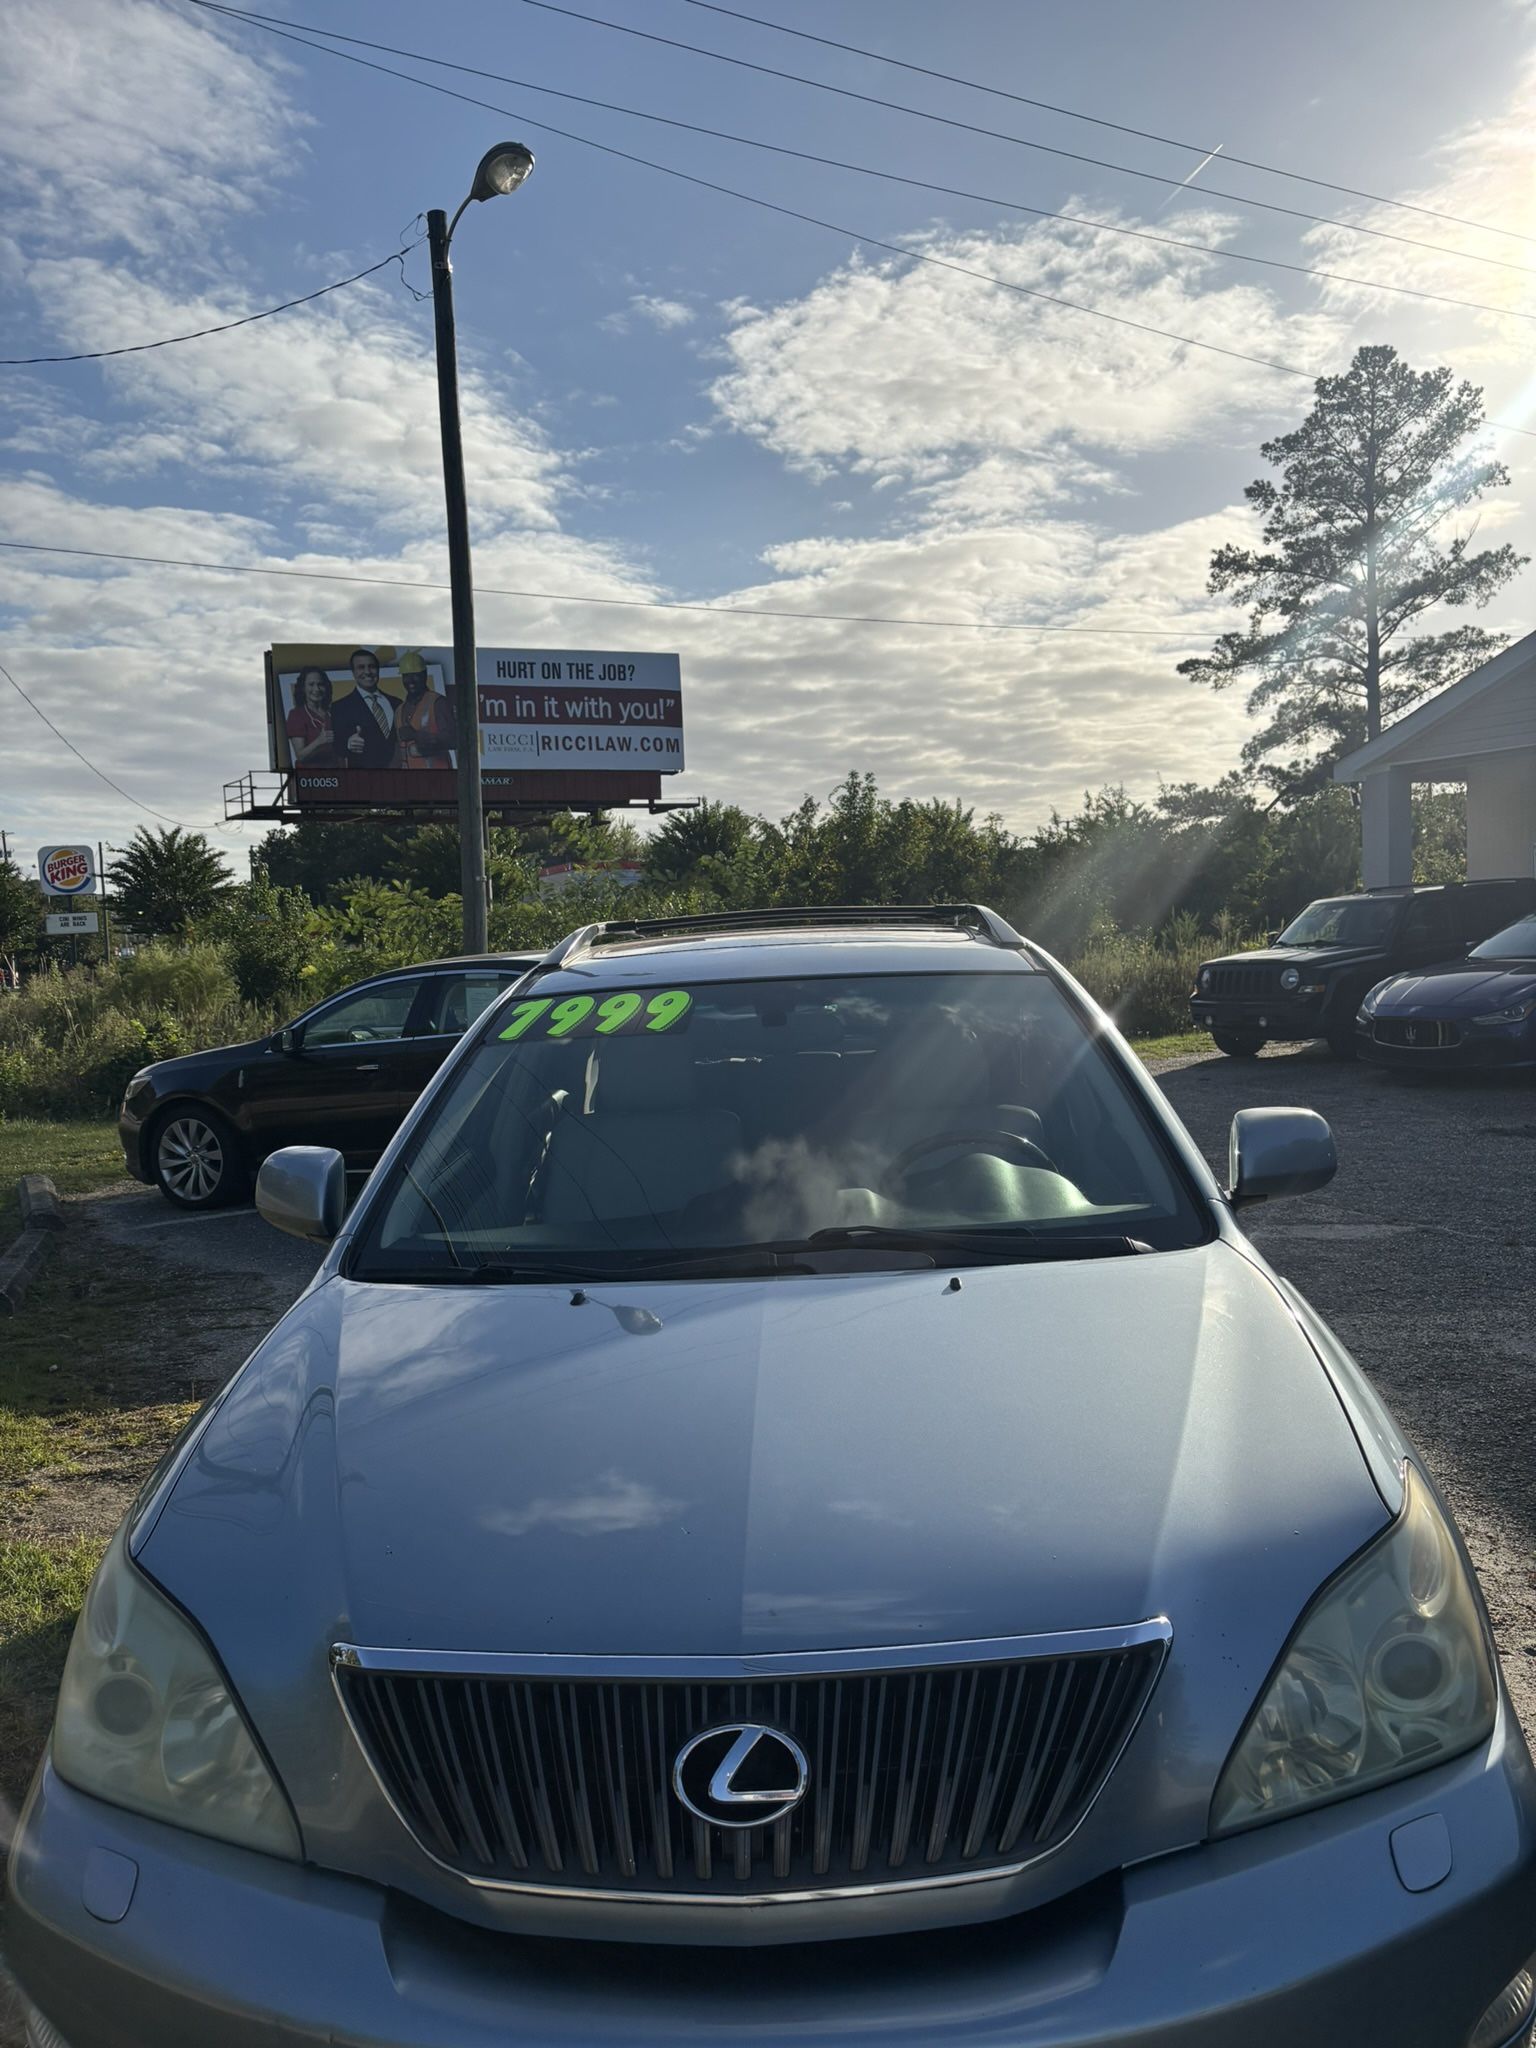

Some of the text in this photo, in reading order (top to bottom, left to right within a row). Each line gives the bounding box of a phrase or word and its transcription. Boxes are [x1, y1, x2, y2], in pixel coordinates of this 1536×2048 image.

[496, 660, 636, 682] HURT ON THE JOB?
[480, 693, 507, 717] 'm
[515, 695, 536, 718] in
[544, 695, 560, 719] it
[564, 696, 612, 719] with
[487, 733, 535, 746] RICCI
[541, 735, 680, 753] RICCILAW.COM
[300, 777, 338, 788] 010053
[480, 777, 510, 785] AMAR
[47, 854, 86, 873] BURGER
[50, 863, 88, 884] KING
[498, 990, 693, 1041] 7999
